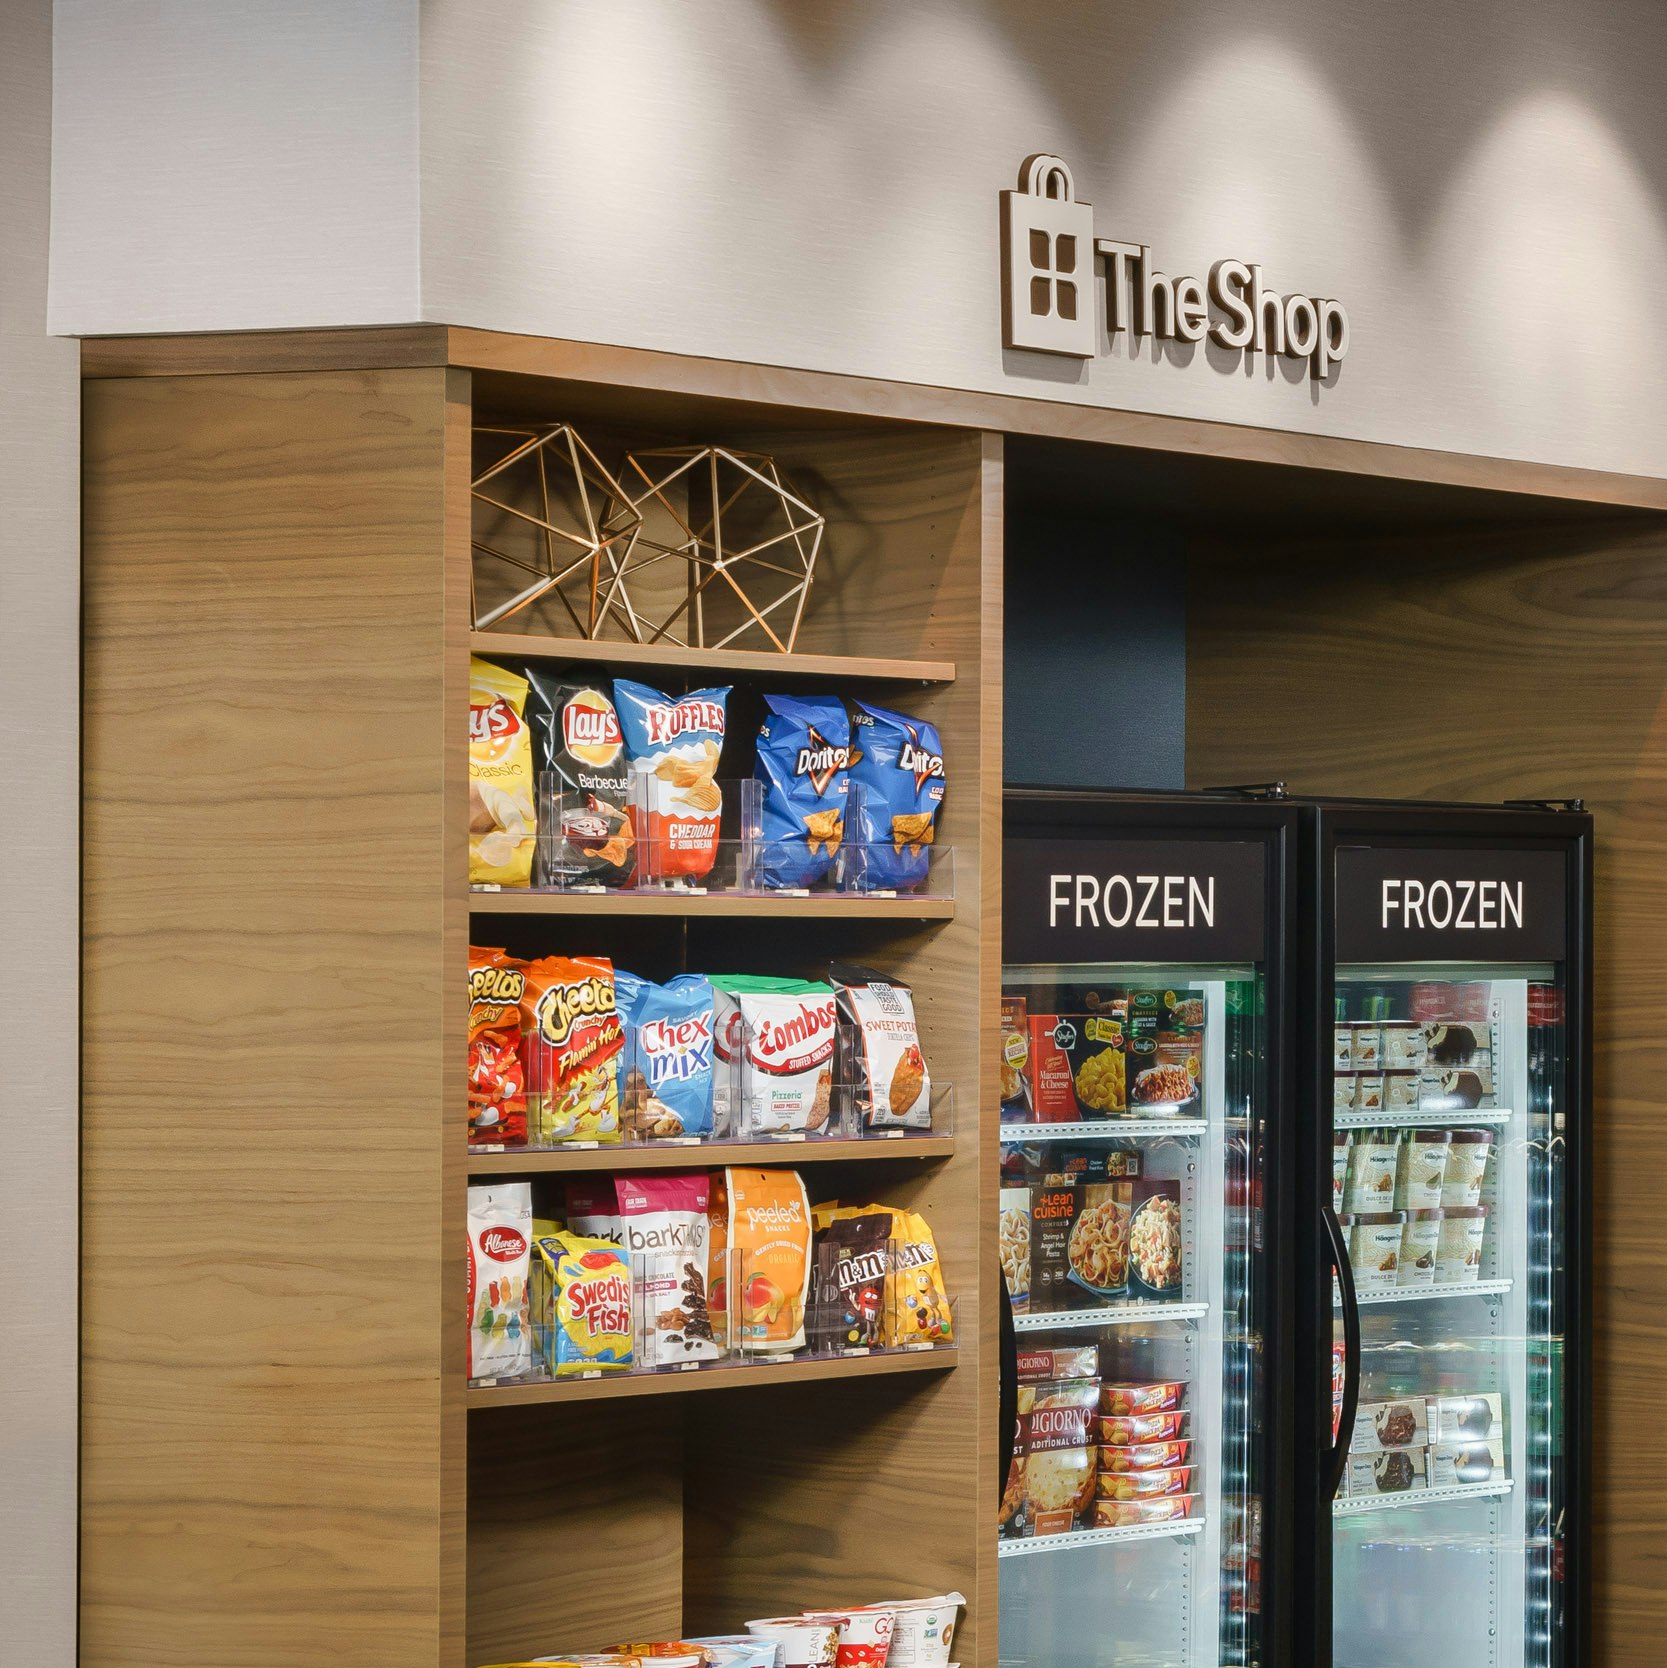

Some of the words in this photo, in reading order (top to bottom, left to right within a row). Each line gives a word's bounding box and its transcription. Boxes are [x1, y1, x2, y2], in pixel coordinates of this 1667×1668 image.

[569, 707, 618, 745] Lay's
[649, 702, 725, 746] RUFFLES
[669, 824, 716, 839] CHEDDAR
[670, 839, 675, 849] &
[678, 840, 693, 849] SOUR
[693, 839, 712, 849] CREAM
[1050, 875, 1215, 927] FROZEN
[1381, 880, 1523, 928] FROZEN
[870, 984, 891, 992] FOOD
[882, 1004, 903, 1012] GOOD
[643, 1013, 710, 1055] Chex
[759, 1002, 836, 1055] Combos
[866, 1021, 895, 1032] SWEET
[789, 1056, 811, 1070] STUFFED
[811, 1043, 833, 1065] SNACKS
[1040, 1071, 1069, 1079] Macaroni
[1046, 1080, 1069, 1089] Cheese
[772, 1091, 801, 1100] Pizzeria
[747, 1200, 800, 1231] peeled
[485, 1233, 523, 1253] Albanese
[587, 1304, 630, 1336] Fish
